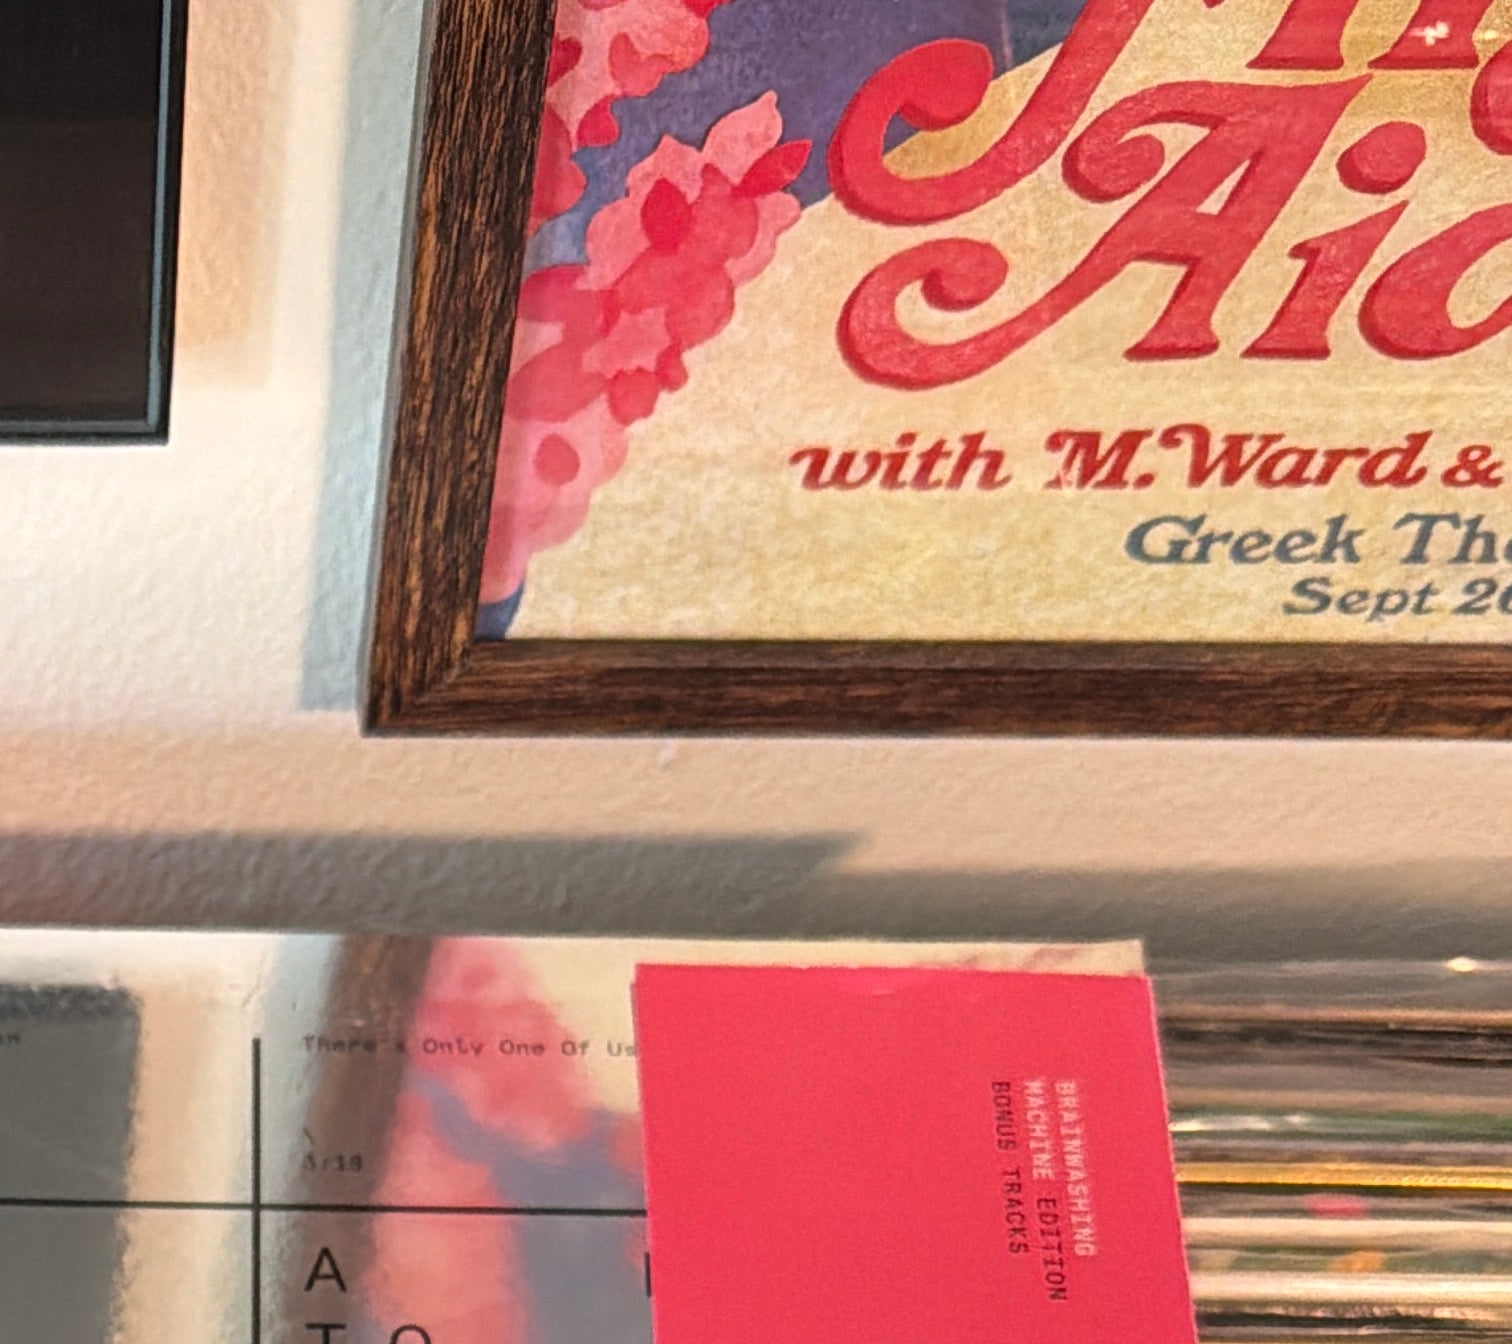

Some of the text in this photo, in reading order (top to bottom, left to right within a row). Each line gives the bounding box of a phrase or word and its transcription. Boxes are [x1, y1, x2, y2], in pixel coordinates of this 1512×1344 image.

[789, 433, 1009, 491] with
[1440, 444, 1504, 488] &
[1124, 513, 1364, 565] Greek
[1282, 577, 1439, 623] Sept
[304, 1034, 407, 1054] Theres
[422, 1037, 484, 1056] Only
[499, 1039, 545, 1056] One
[562, 1040, 590, 1056] Of
[992, 1081, 1029, 1254] BONUS TRACKS
[1024, 1079, 1067, 1302] MACHINE EDITION
[304, 1247, 347, 1293] A
